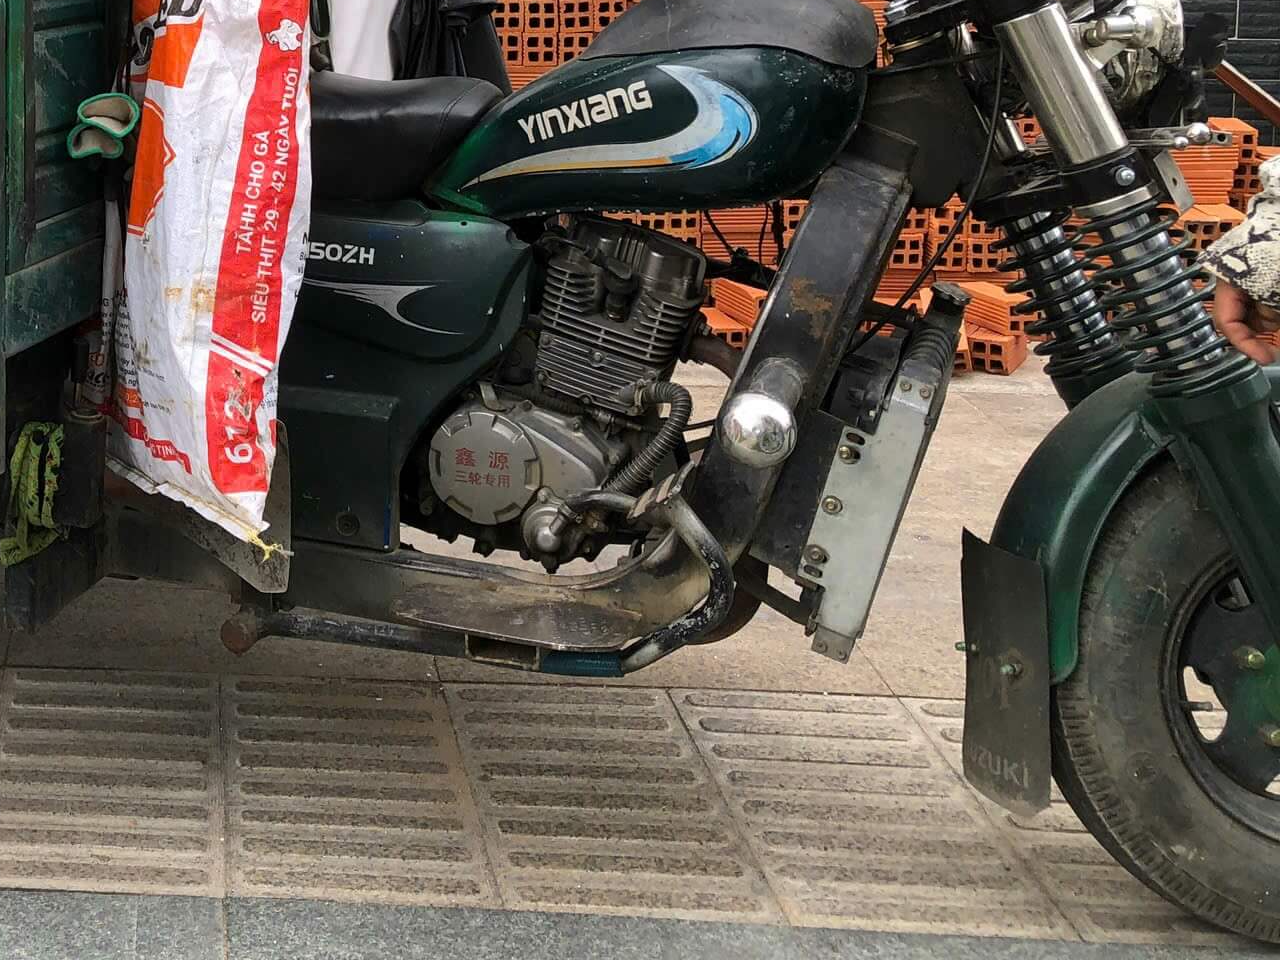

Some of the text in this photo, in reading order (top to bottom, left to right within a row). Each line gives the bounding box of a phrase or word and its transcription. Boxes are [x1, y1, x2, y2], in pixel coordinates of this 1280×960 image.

[282, 67, 299, 110] TUỔI
[518, 80, 653, 145] YINXIANG
[251, 129, 270, 166] GÀ
[275, 119, 291, 167] NGÀY
[245, 169, 262, 208] CHO
[271, 168, 287, 194] 42
[261, 208, 279, 238] 29
[257, 237, 275, 283] THỊT
[251, 283, 267, 324] SIÊU
[224, 400, 253, 464] 612
[454, 470, 511, 488] 三轮专用
